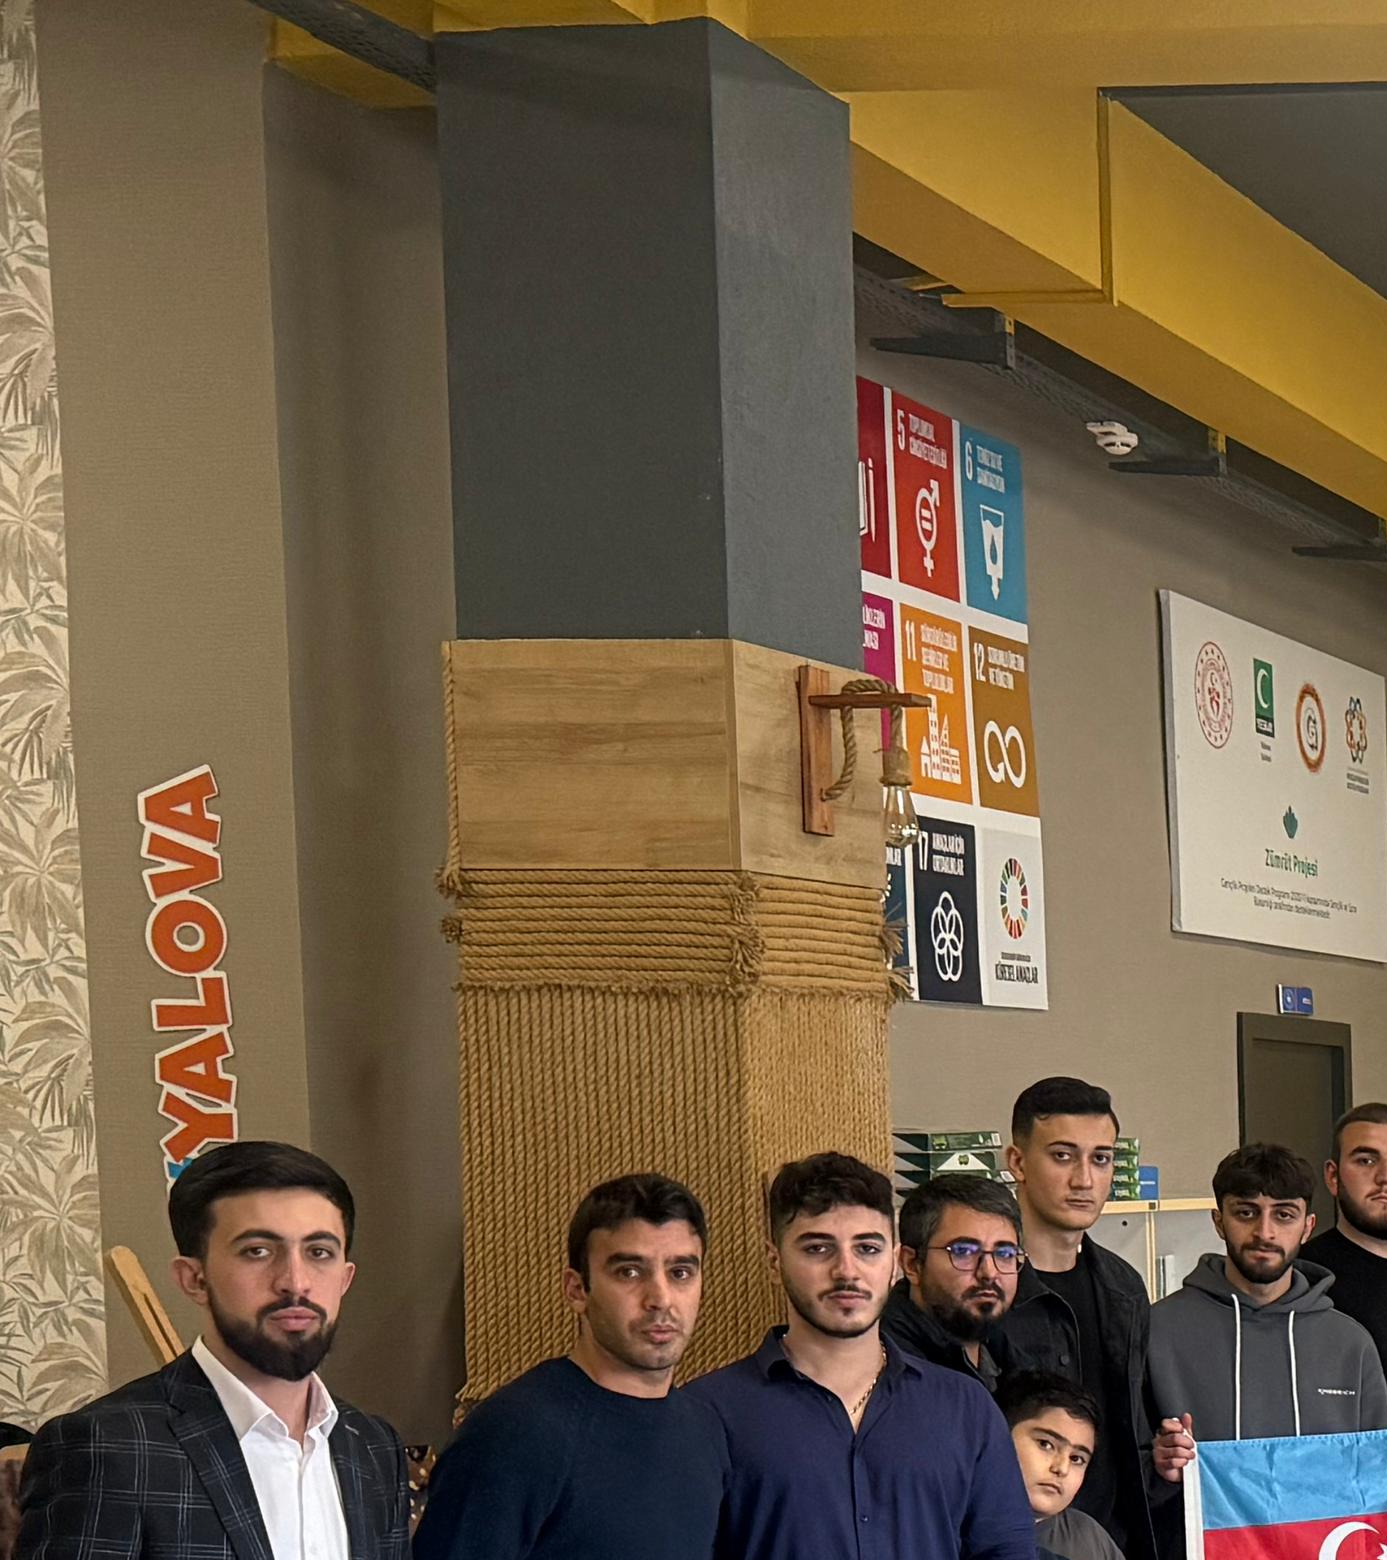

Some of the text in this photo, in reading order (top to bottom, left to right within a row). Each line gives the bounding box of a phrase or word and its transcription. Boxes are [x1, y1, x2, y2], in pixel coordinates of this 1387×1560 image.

[896, 407, 906, 452] 5
[964, 439, 974, 482] 6
[904, 619, 917, 662] 11
[973, 641, 987, 683] 12
[138, 764, 238, 1195] YALOVA
